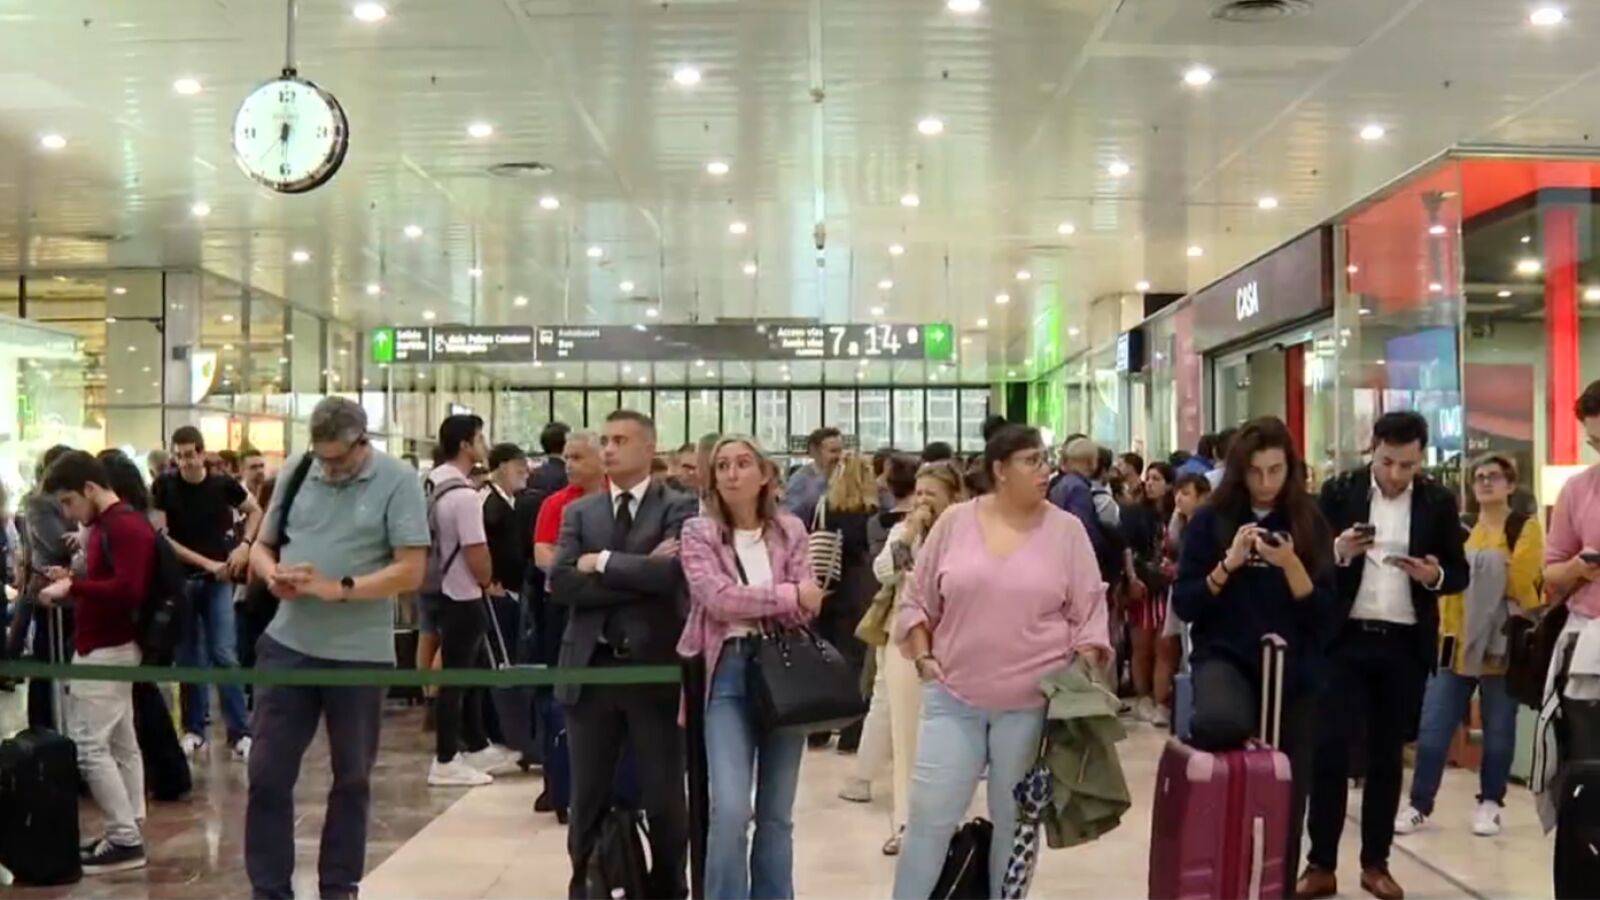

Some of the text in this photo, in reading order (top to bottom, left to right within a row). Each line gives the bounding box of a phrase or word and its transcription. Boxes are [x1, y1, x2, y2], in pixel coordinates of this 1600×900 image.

[1235, 281, 1260, 321] CASA
[829, 327, 846, 356] 7
[864, 325, 901, 355] 14
